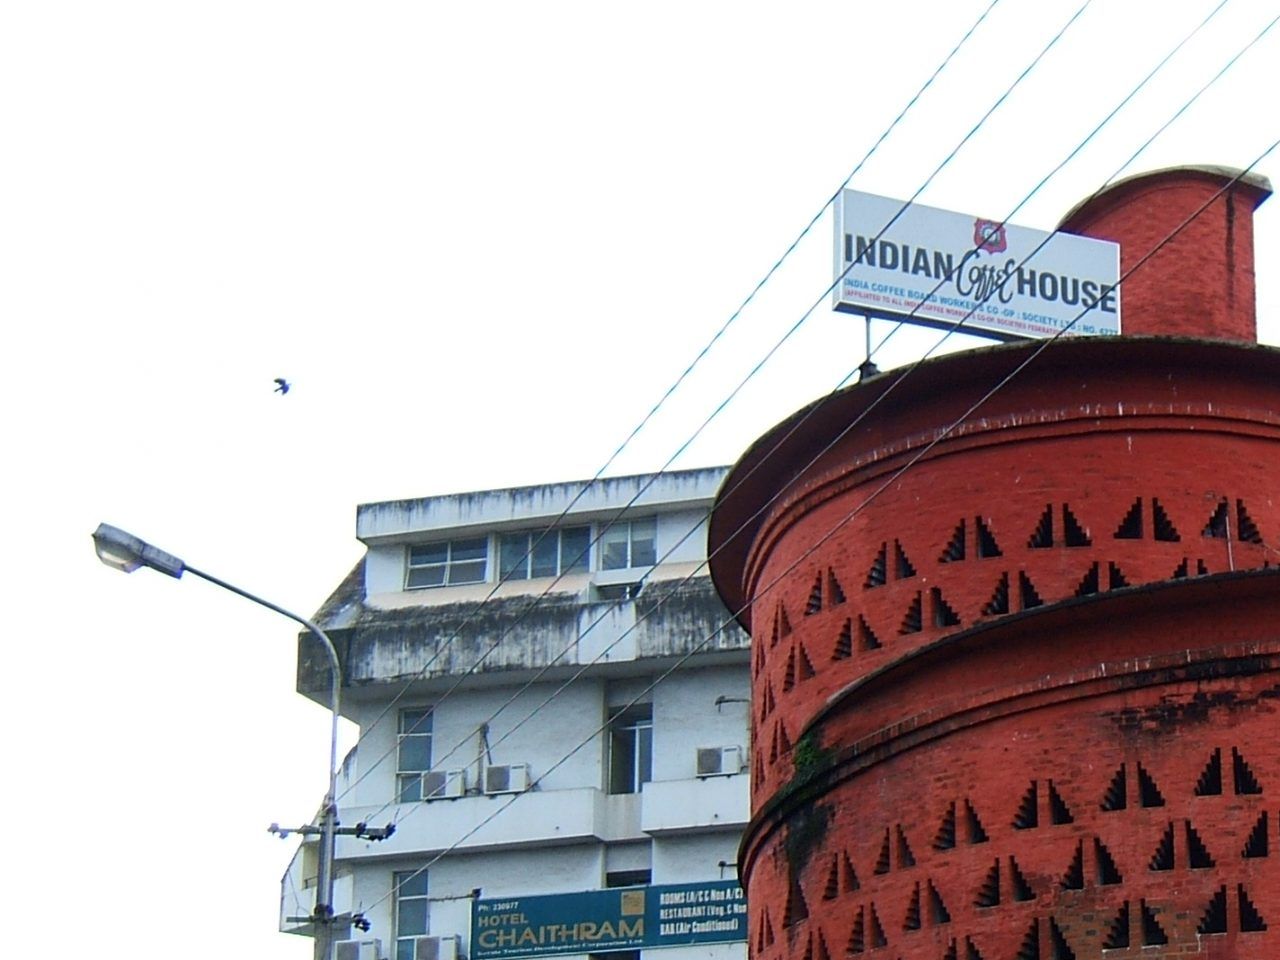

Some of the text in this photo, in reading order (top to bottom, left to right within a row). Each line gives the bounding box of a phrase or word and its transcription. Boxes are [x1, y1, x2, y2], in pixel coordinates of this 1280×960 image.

[845, 233, 952, 283] INDIAN
[1017, 266, 1116, 314] HOUSE
[843, 278, 869, 290] INDIA
[871, 283, 905, 297] COFFEE
[1022, 312, 1057, 327] SOCIETY
[904, 300, 921, 309] INDI
[945, 308, 975, 320] WORKES
[660, 891, 685, 905] ROOMS
[478, 913, 528, 928] HOTEL
[660, 905, 706, 919] RESTAURANT
[478, 918, 644, 949] CHAITHRAM
[660, 923, 675, 936] BAR
